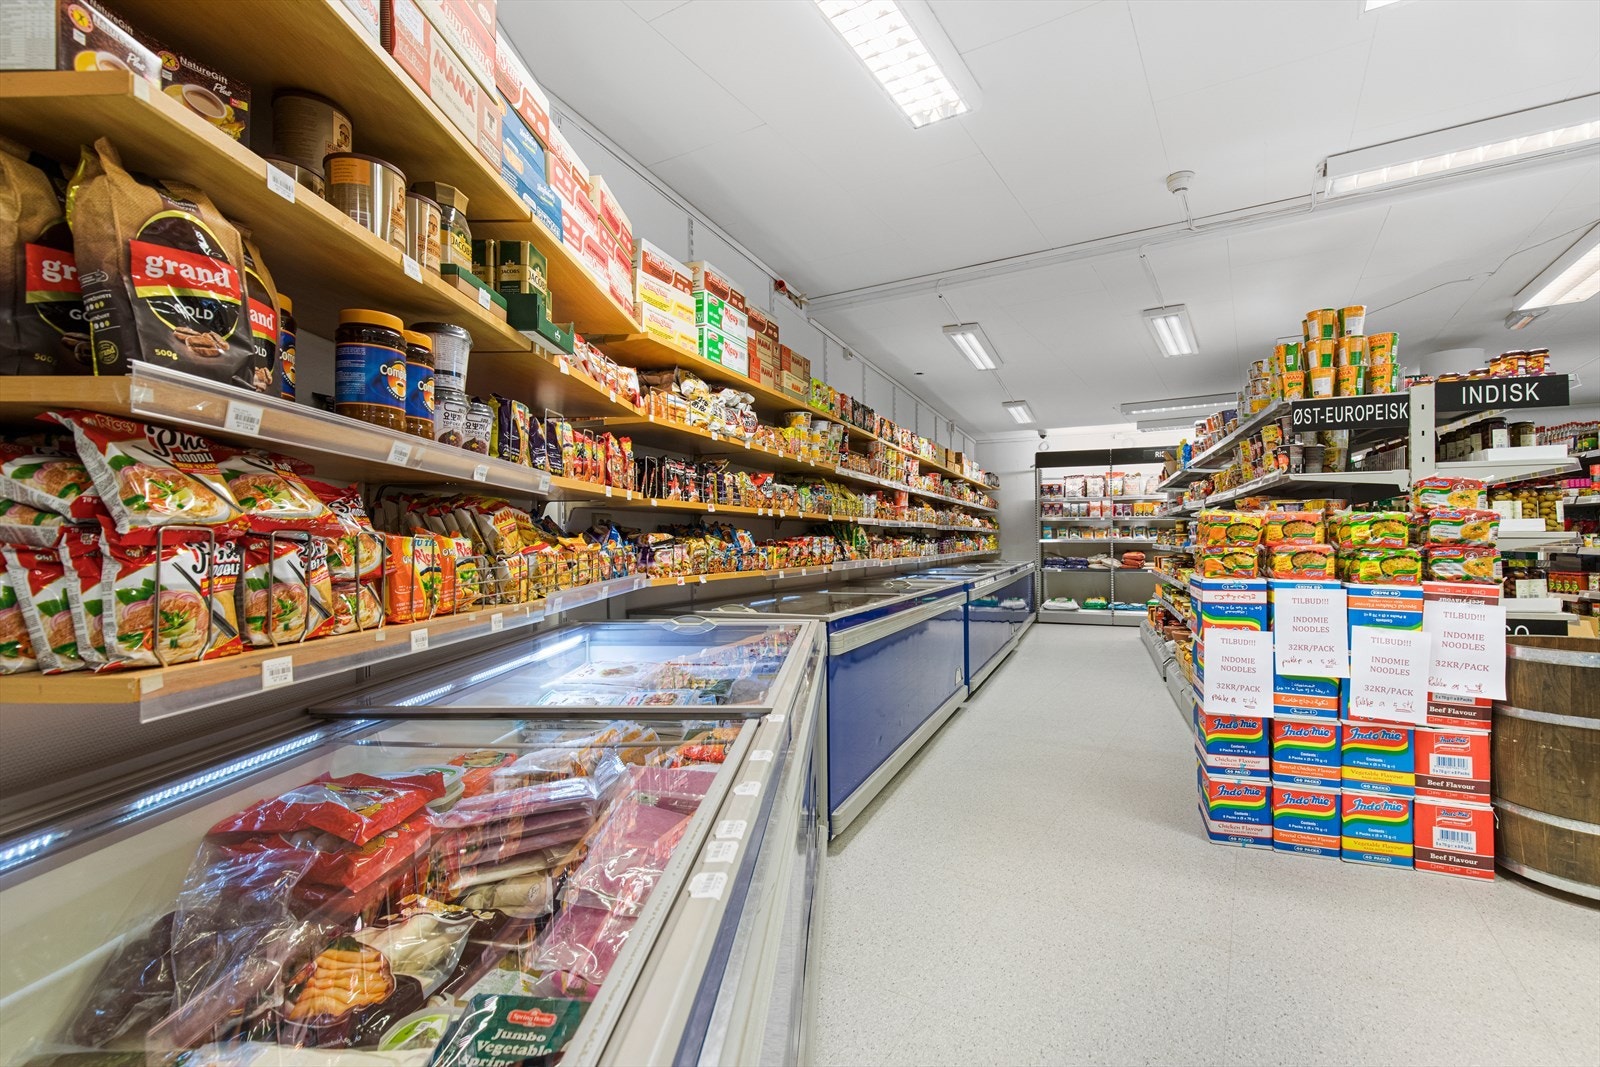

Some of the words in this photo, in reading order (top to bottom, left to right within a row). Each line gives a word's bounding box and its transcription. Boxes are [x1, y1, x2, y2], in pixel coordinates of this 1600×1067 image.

[179, 55, 229, 85] NatureGift
[433, 49, 476, 113] MAMA
[212, 82, 233, 98] Plus
[145, 255, 232, 288] grand
[154, 347, 179, 361] 500g
[1462, 382, 1540, 405] INDISK
[1293, 402, 1410, 426] ØST-EUROPEISK
[144, 424, 209, 458] Pho
[1291, 597, 1329, 606] TILBUD!!!
[1293, 616, 1329, 624] INDOMIE
[1443, 611, 1486, 622] TILBUD!!!
[1292, 625, 1330, 633] NOODLES
[1443, 630, 1485, 641] INDOMIE
[1220, 637, 1256, 647] TILBUD!!!
[1370, 636, 1412, 647] TILBUD!!!
[1441, 640, 1486, 651] NOODLES
[1288, 643, 1335, 652] 32KR/PACK
[1221, 655, 1256, 665] INDOMIE
[1371, 656, 1410, 667] INDOMIE
[1220, 664, 1257, 674] NOODLES
[1370, 665, 1411, 677] NOODLES
[1435, 660, 1489, 672] 32KR/PACK
[1216, 682, 1261, 693] 32KR/PACK
[1364, 684, 1414, 696] 32KR/PACK
[1429, 706, 1446, 714] Beef
[1447, 708, 1477, 717] Flavour
[1427, 779, 1444, 787] Beef
[1445, 780, 1475, 790] Flavour
[1430, 852, 1446, 861] Beef
[1448, 854, 1479, 865] Flavour
[491, 1029, 546, 1041] Jumbo
[476, 1040, 553, 1057] Vegetable
